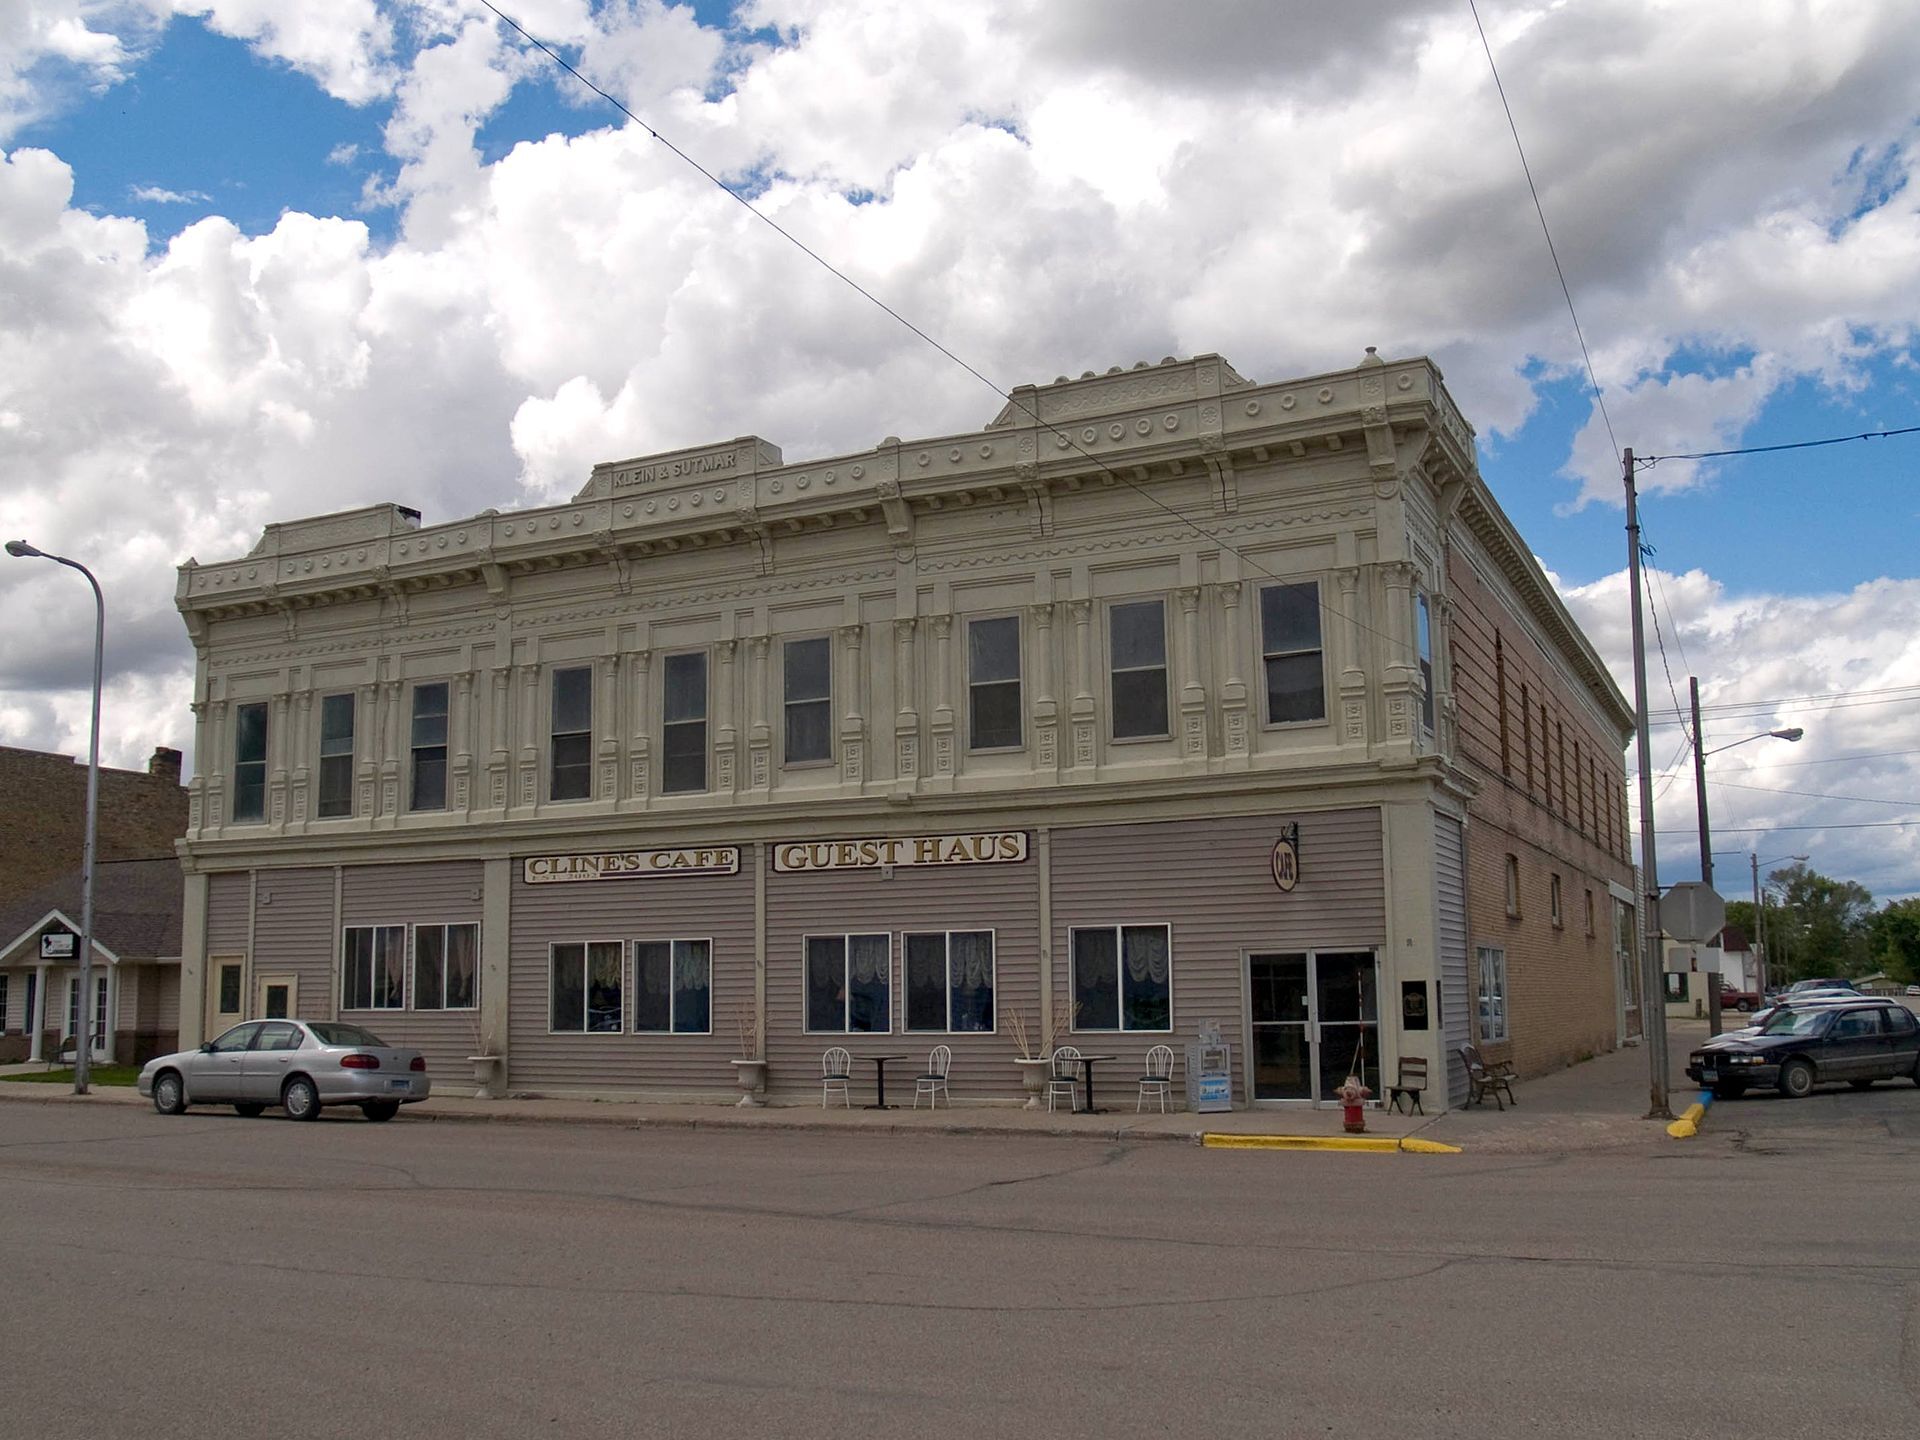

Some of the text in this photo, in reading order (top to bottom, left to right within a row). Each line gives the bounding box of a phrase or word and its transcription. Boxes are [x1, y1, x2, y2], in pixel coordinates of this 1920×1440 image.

[614, 453, 736, 488] KLEIN & SUTMAR
[528, 849, 734, 875] CLINE'S CAFE
[781, 834, 1021, 869] GUEST HAUS
